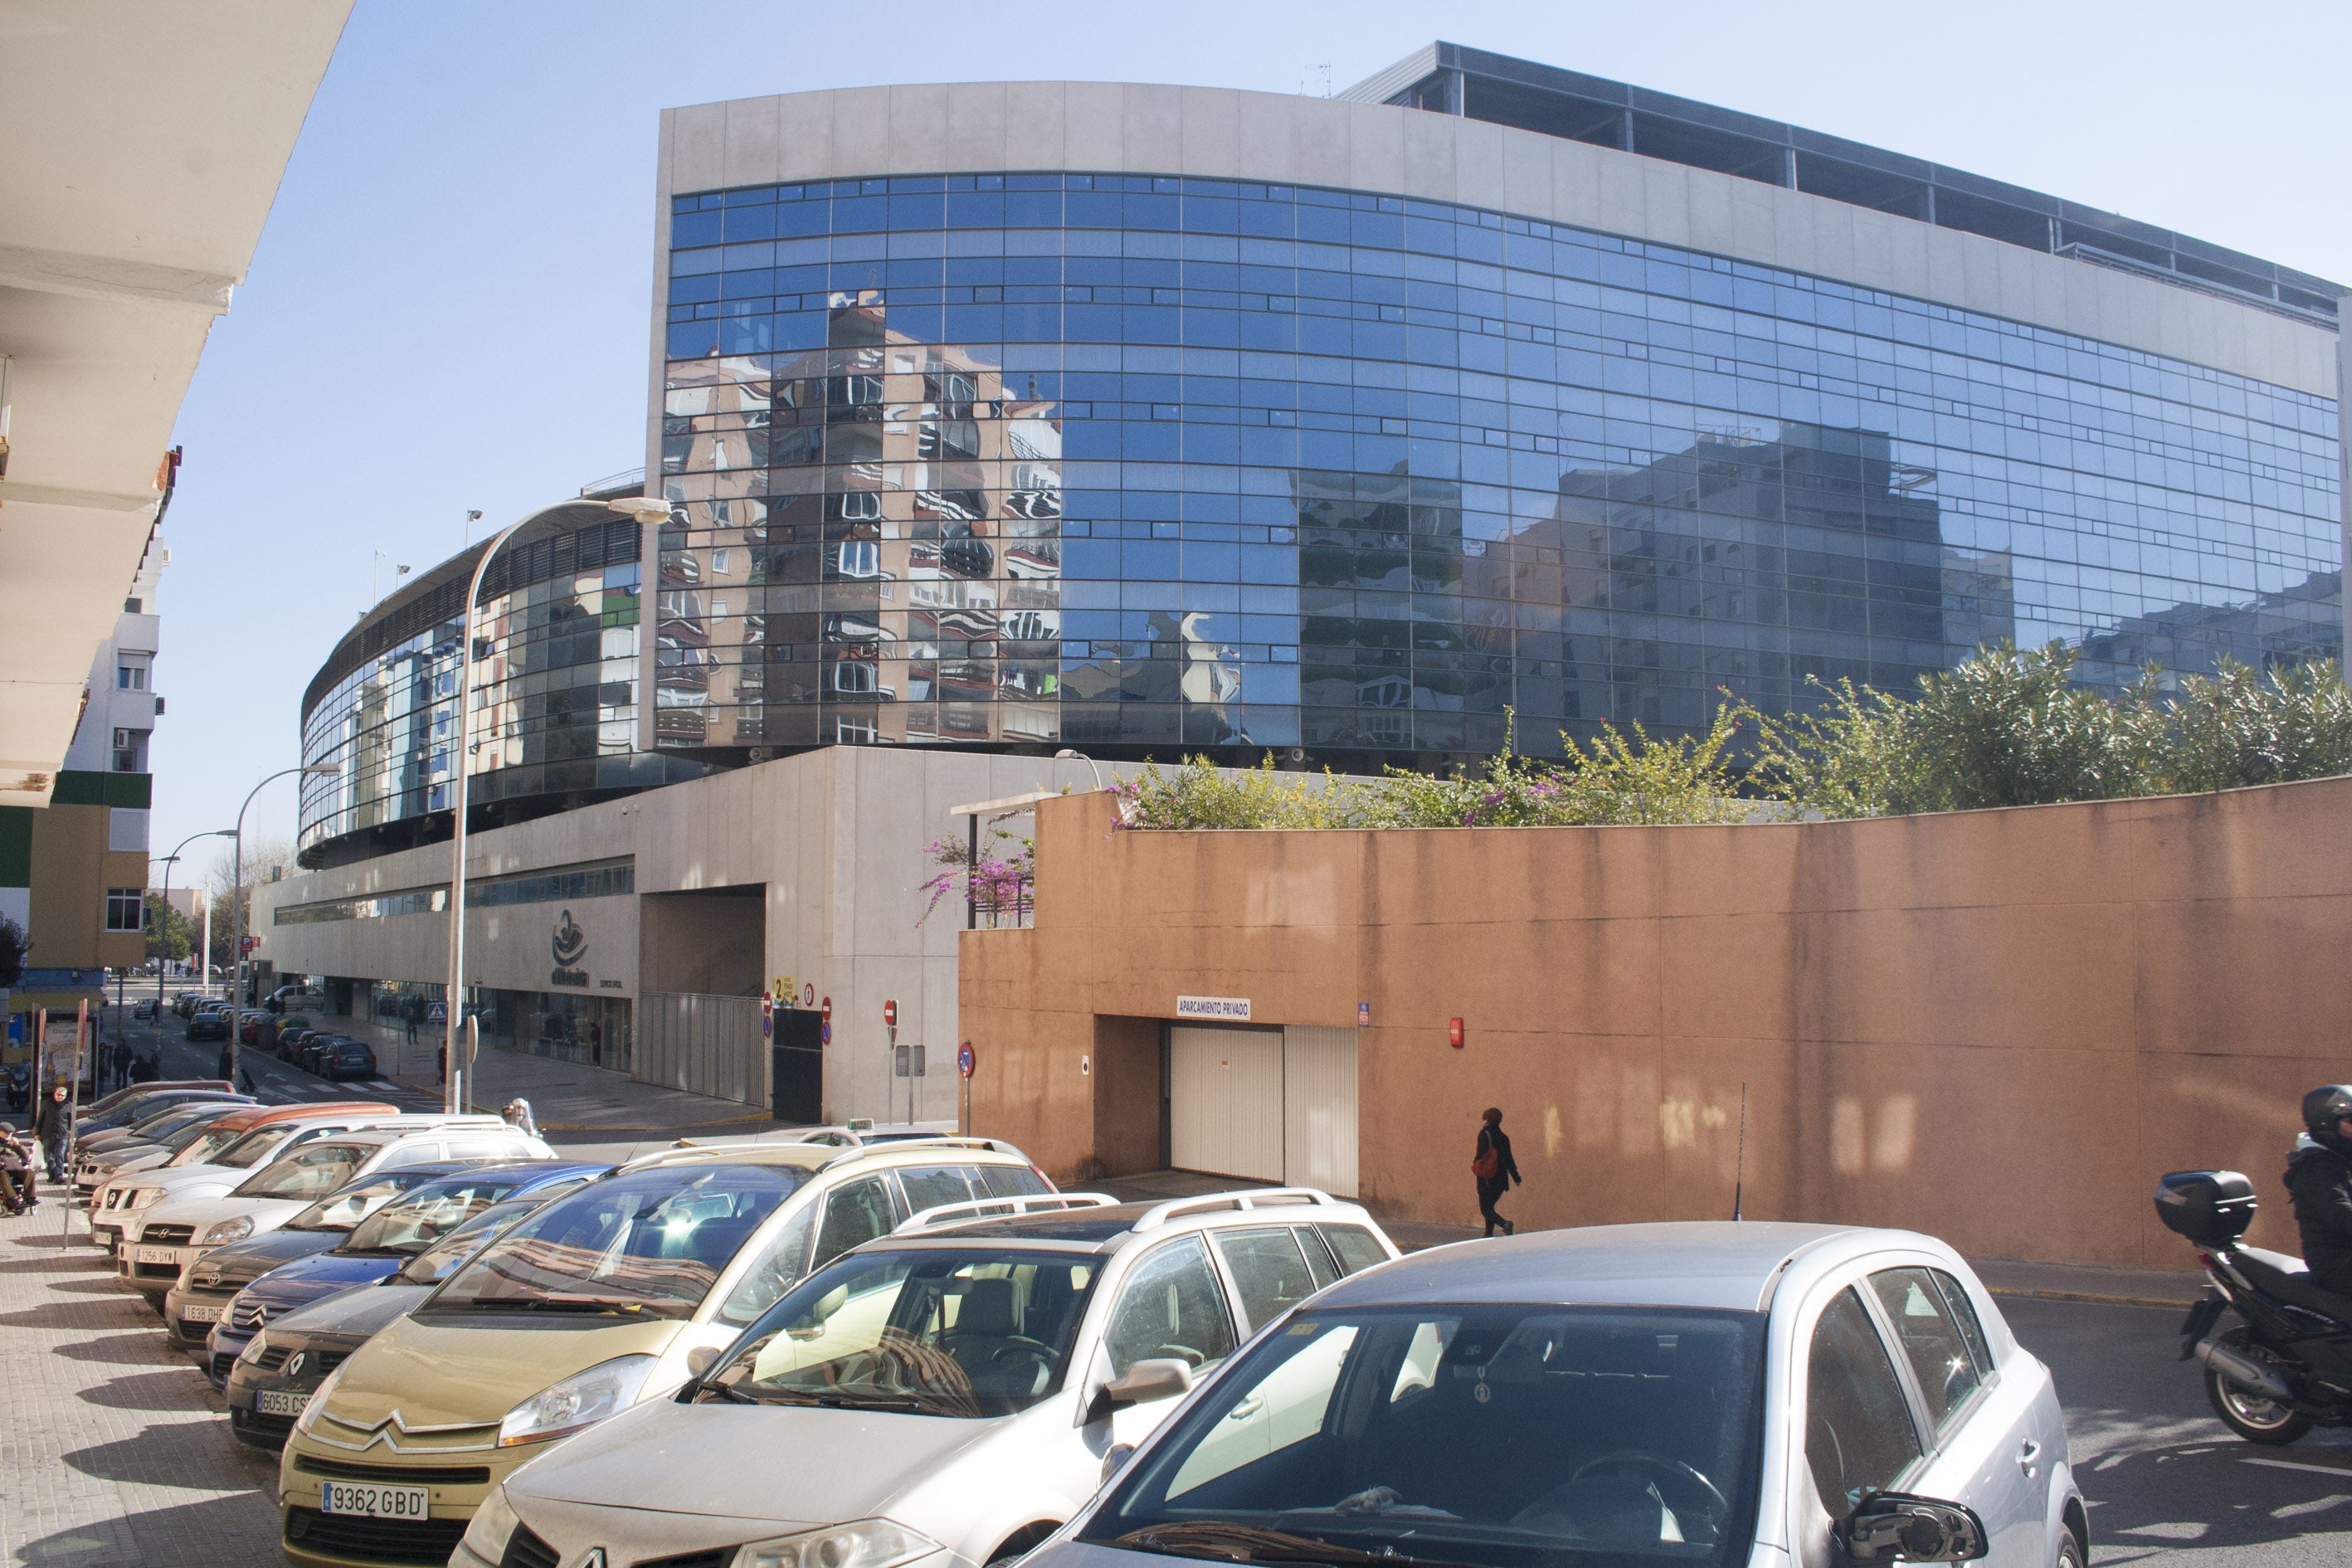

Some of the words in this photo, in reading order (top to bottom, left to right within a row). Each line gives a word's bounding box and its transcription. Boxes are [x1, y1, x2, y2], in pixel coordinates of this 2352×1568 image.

[776, 979, 782, 998] 2
[1179, 1000, 1222, 1015] APARCAMIENTO
[1223, 1002, 1249, 1016] PRIVADO
[142, 1250, 158, 1262] 1256
[187, 1307, 206, 1320] 1638
[263, 1394, 289, 1412] 6053
[292, 1396, 311, 1413] CS
[334, 1487, 377, 1512] 9362
[382, 1490, 421, 1516] GBD
